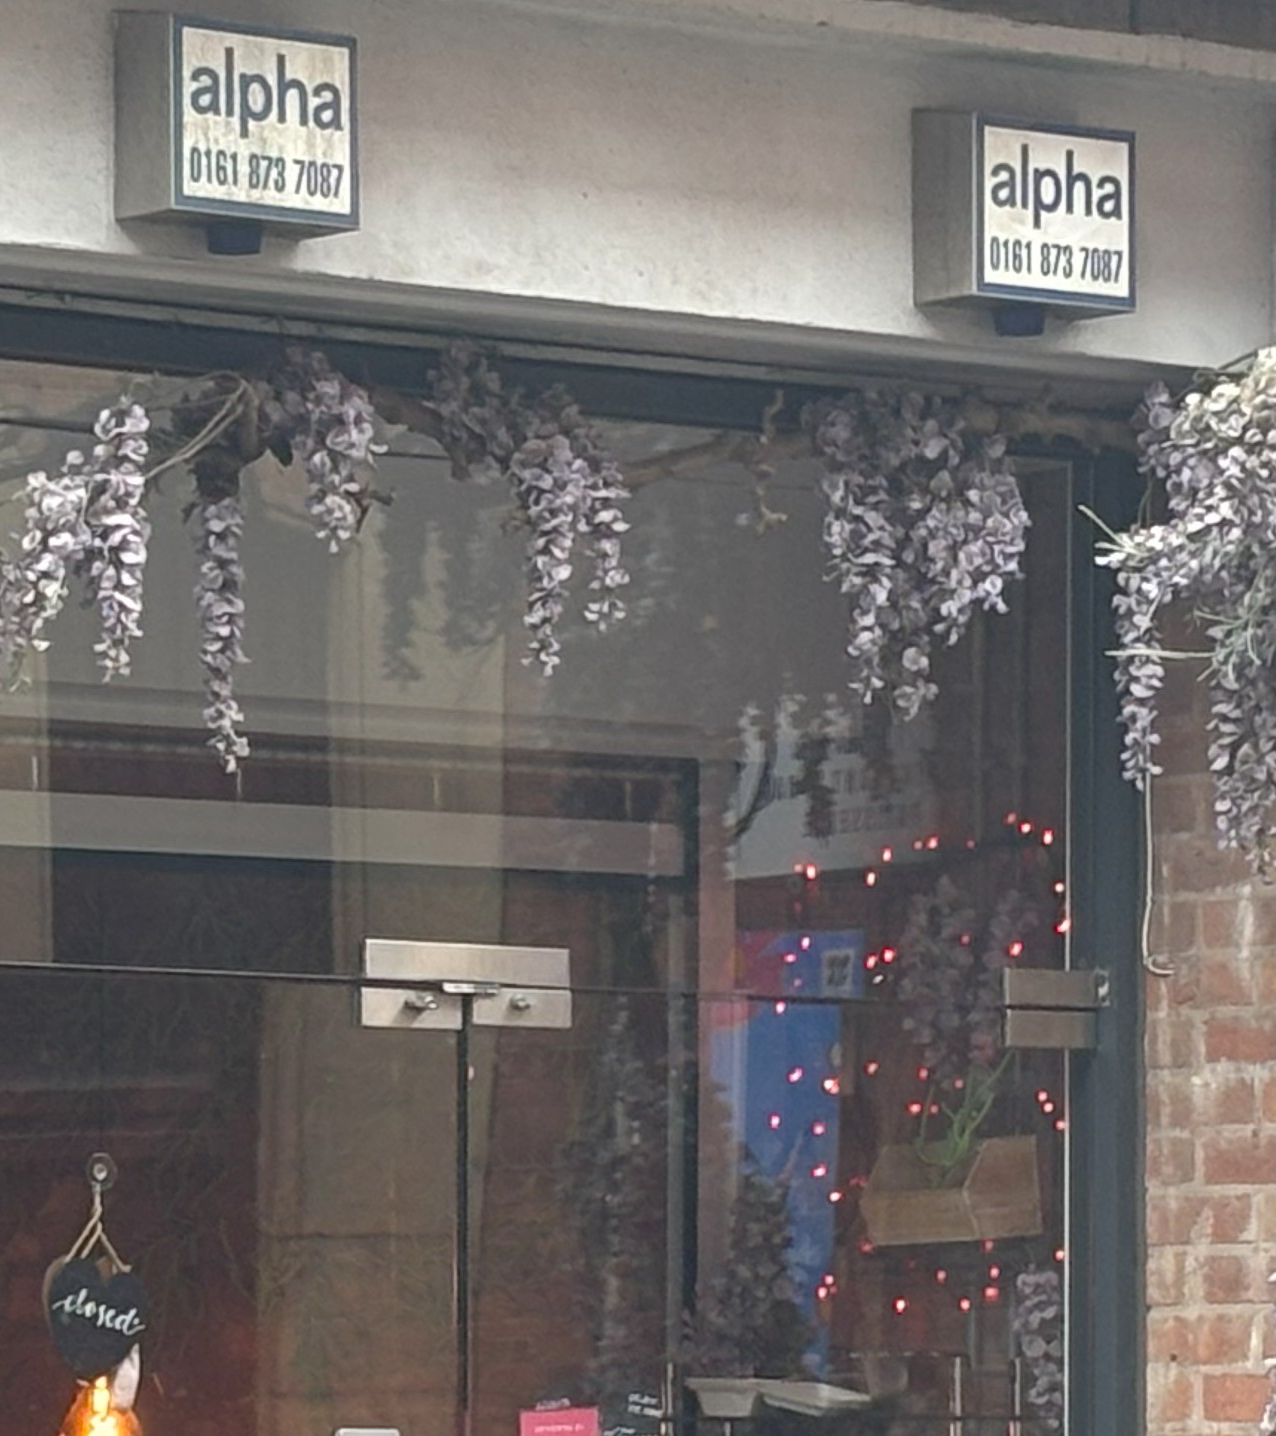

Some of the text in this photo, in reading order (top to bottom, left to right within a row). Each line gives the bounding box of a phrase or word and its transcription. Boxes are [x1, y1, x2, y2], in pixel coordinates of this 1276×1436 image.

[190, 46, 344, 139] alpha
[189, 146, 344, 199] 0161 873 7087
[990, 143, 1123, 229] alpha
[989, 236, 1124, 284] 0161 873 7087
